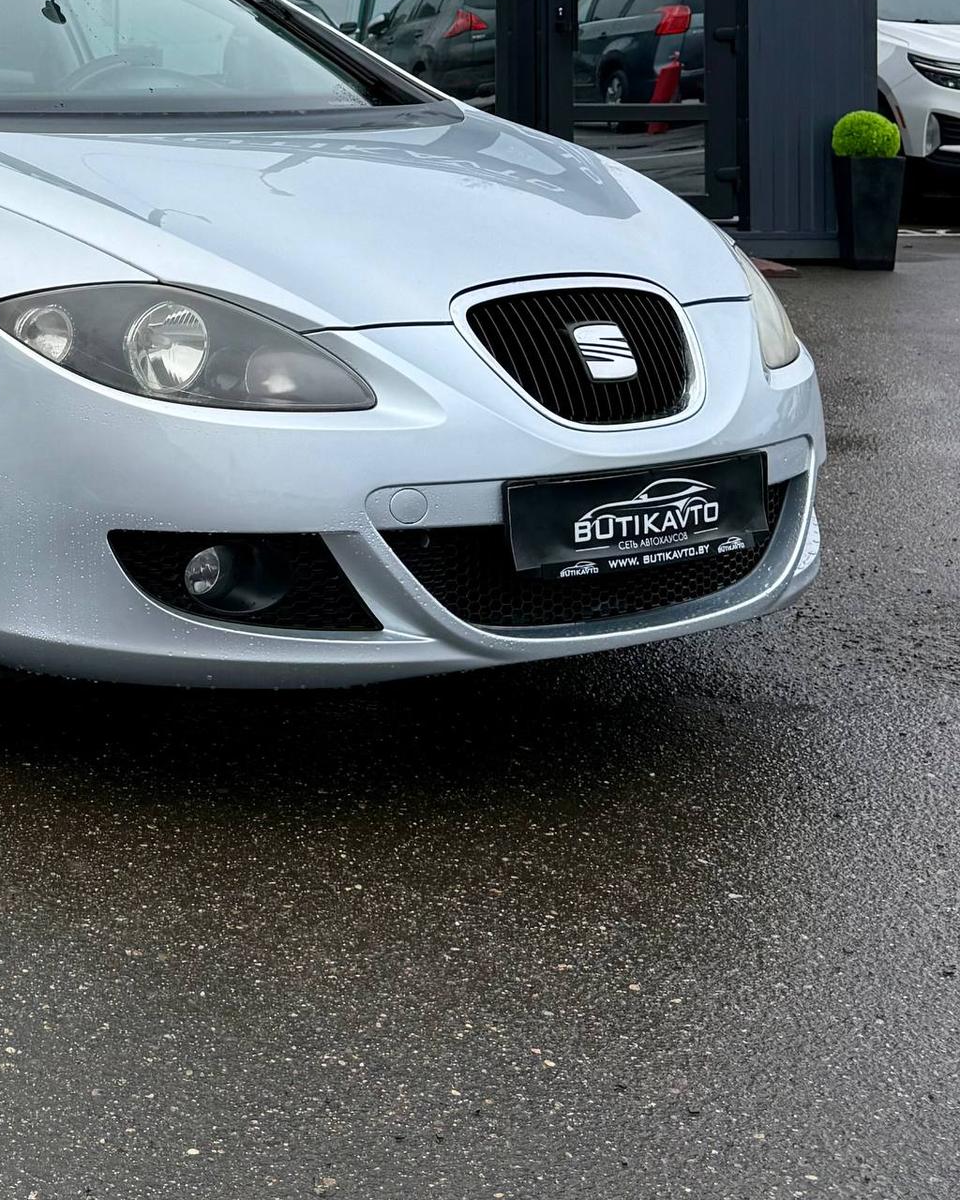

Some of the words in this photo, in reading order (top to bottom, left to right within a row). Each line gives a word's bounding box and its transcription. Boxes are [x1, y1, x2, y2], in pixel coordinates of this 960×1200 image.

[574, 501, 719, 543] BUTIKAVTO
[618, 539, 639, 550] СЕТЬ
[640, 532, 689, 548] АВТОХАУСОВ
[608, 556, 640, 569] WWW.
[642, 544, 710, 565] BUTIKAVTO.BY
